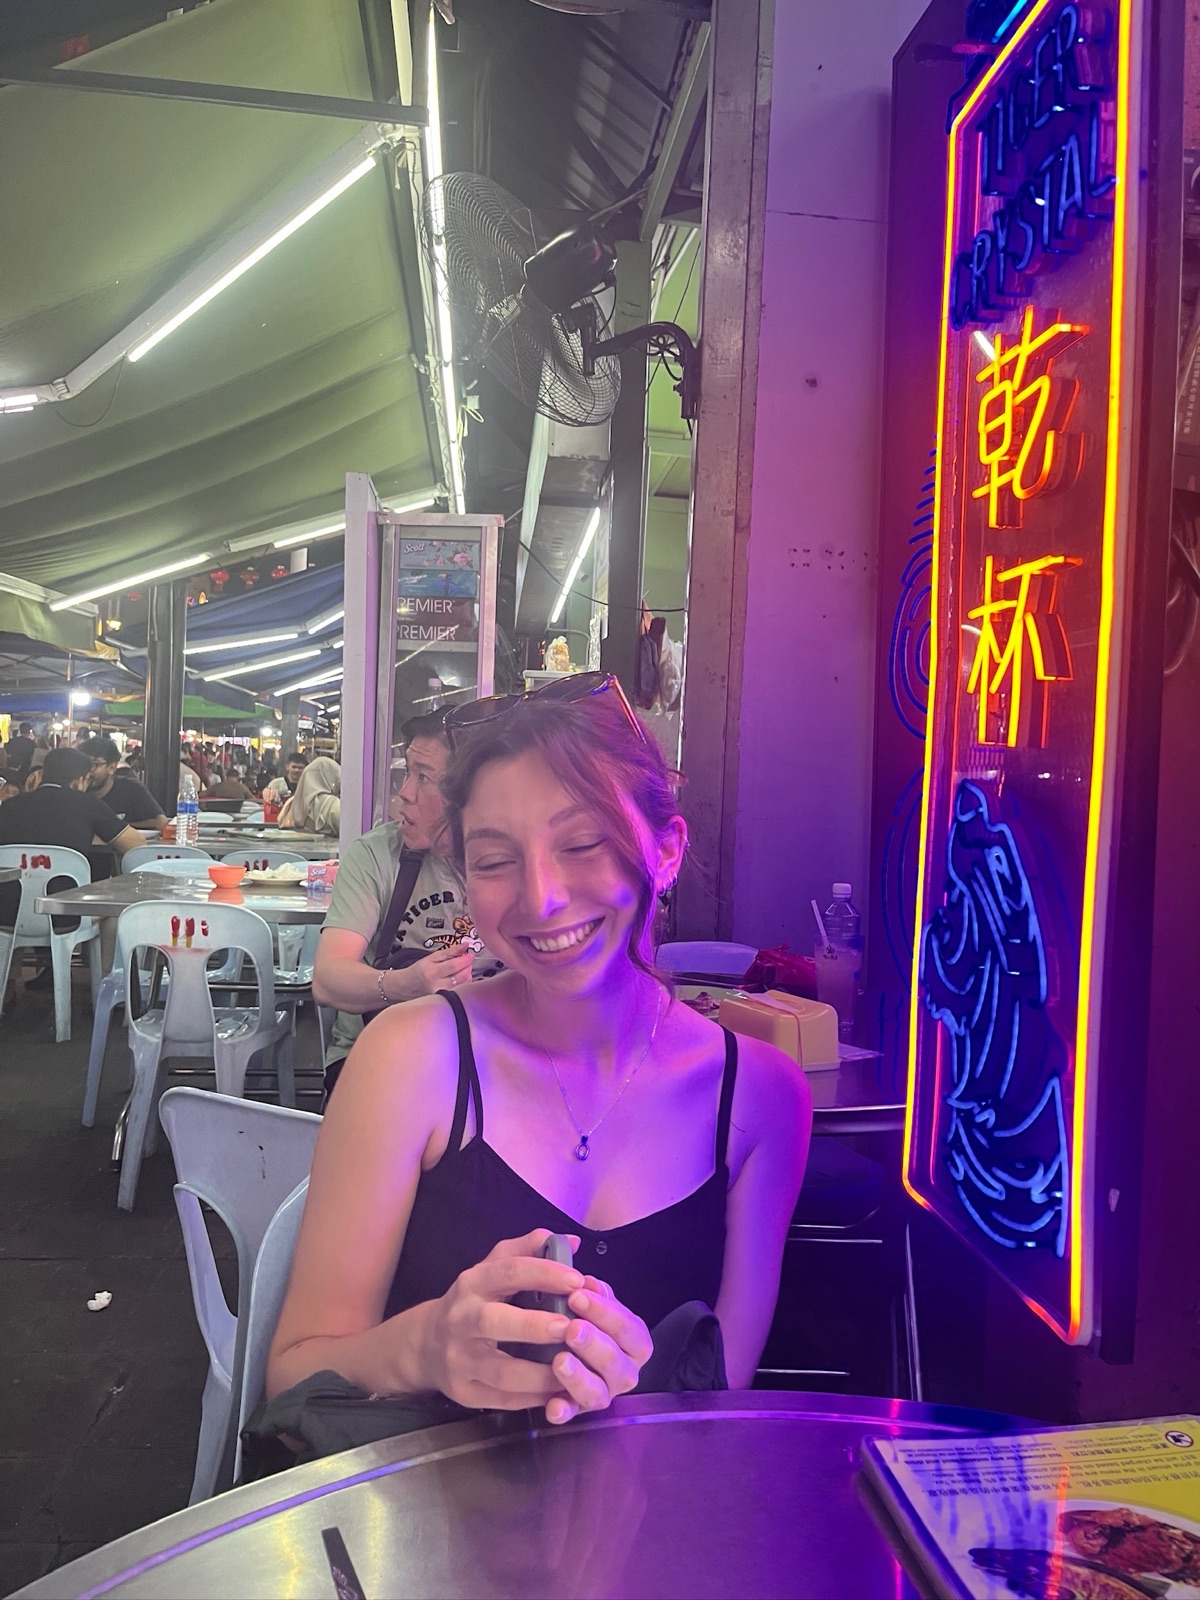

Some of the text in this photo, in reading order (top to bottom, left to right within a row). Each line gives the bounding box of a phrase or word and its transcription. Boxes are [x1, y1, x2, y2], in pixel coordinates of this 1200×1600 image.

[976, 4, 1086, 196] TIGER
[950, 102, 1120, 331] CRYSTAL
[404, 542, 425, 554] Scott
[966, 304, 1090, 748] 乾杯
[402, 890, 455, 925] TIGER
